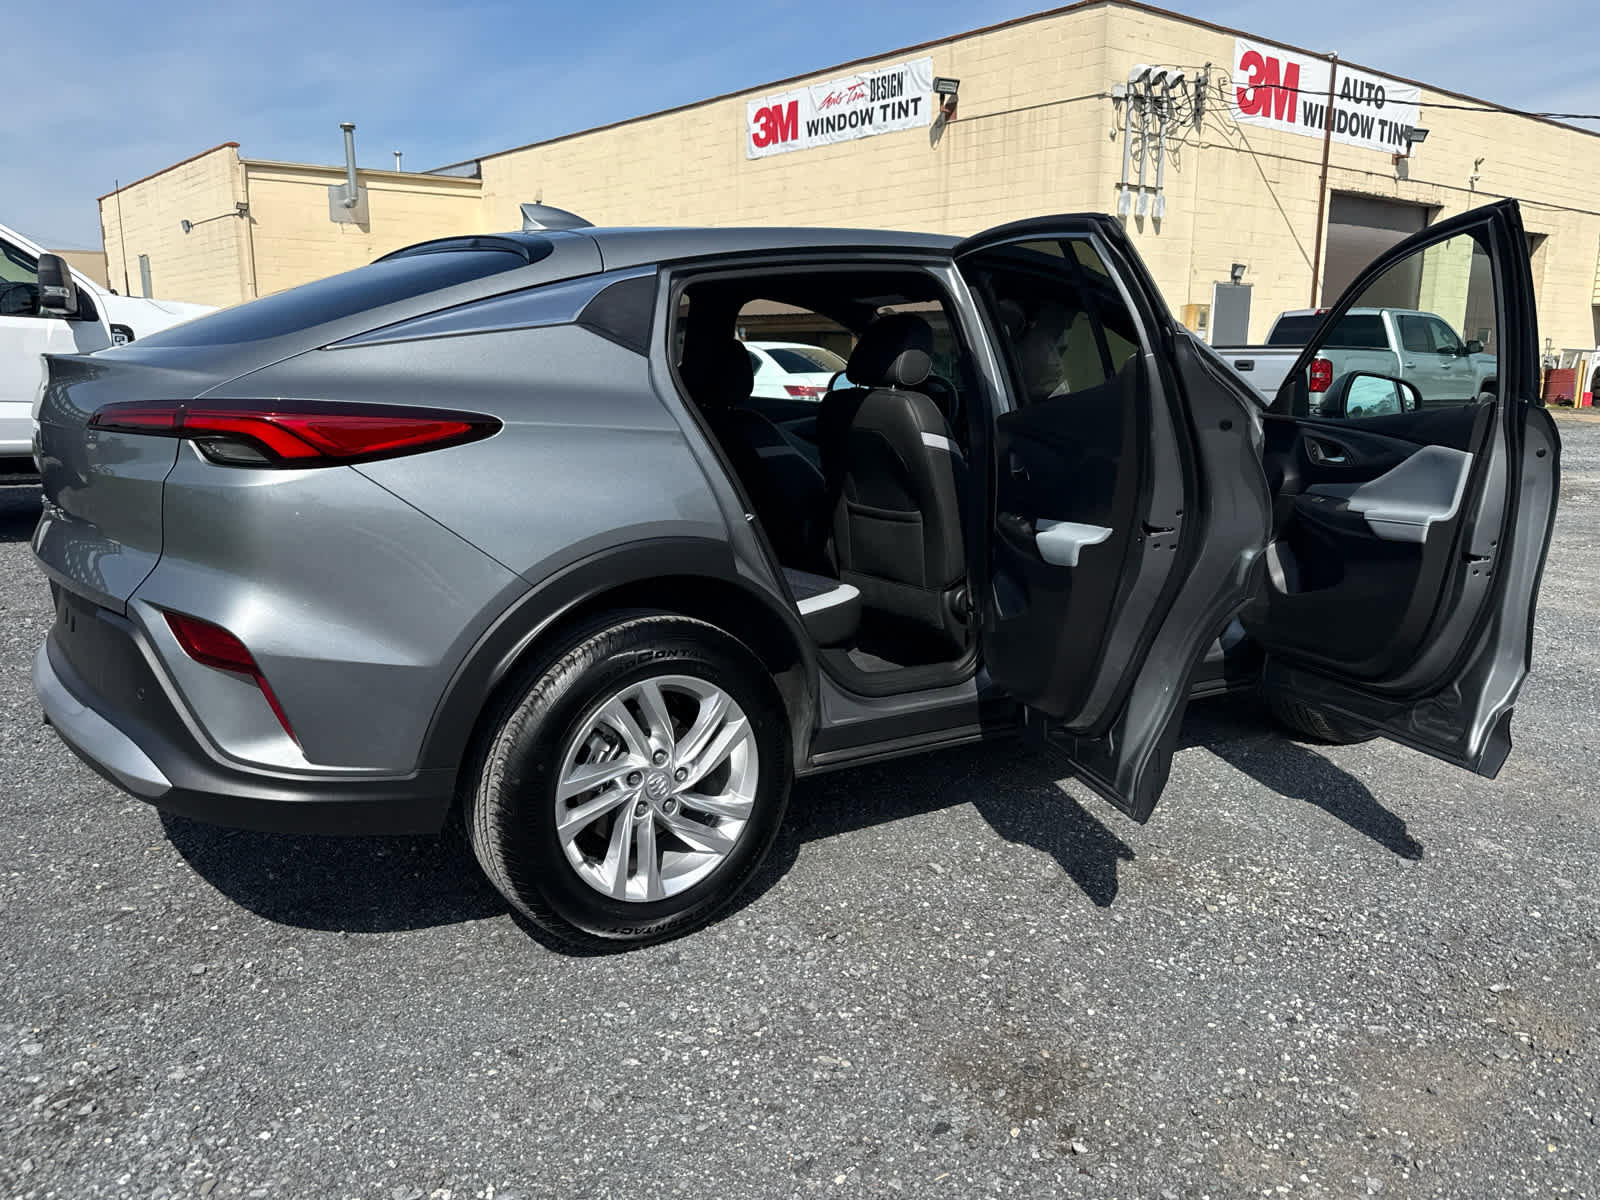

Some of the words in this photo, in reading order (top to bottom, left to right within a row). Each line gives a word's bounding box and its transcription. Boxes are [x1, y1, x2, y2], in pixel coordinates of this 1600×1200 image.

[869, 71, 904, 103] DESIGN
[1236, 50, 1300, 123] 3M
[1340, 76, 1386, 109] AUTO
[752, 100, 799, 148] 3M
[806, 107, 875, 138] WINDOW
[880, 96, 922, 122] TINT
[1303, 100, 1375, 139] WINDOW
